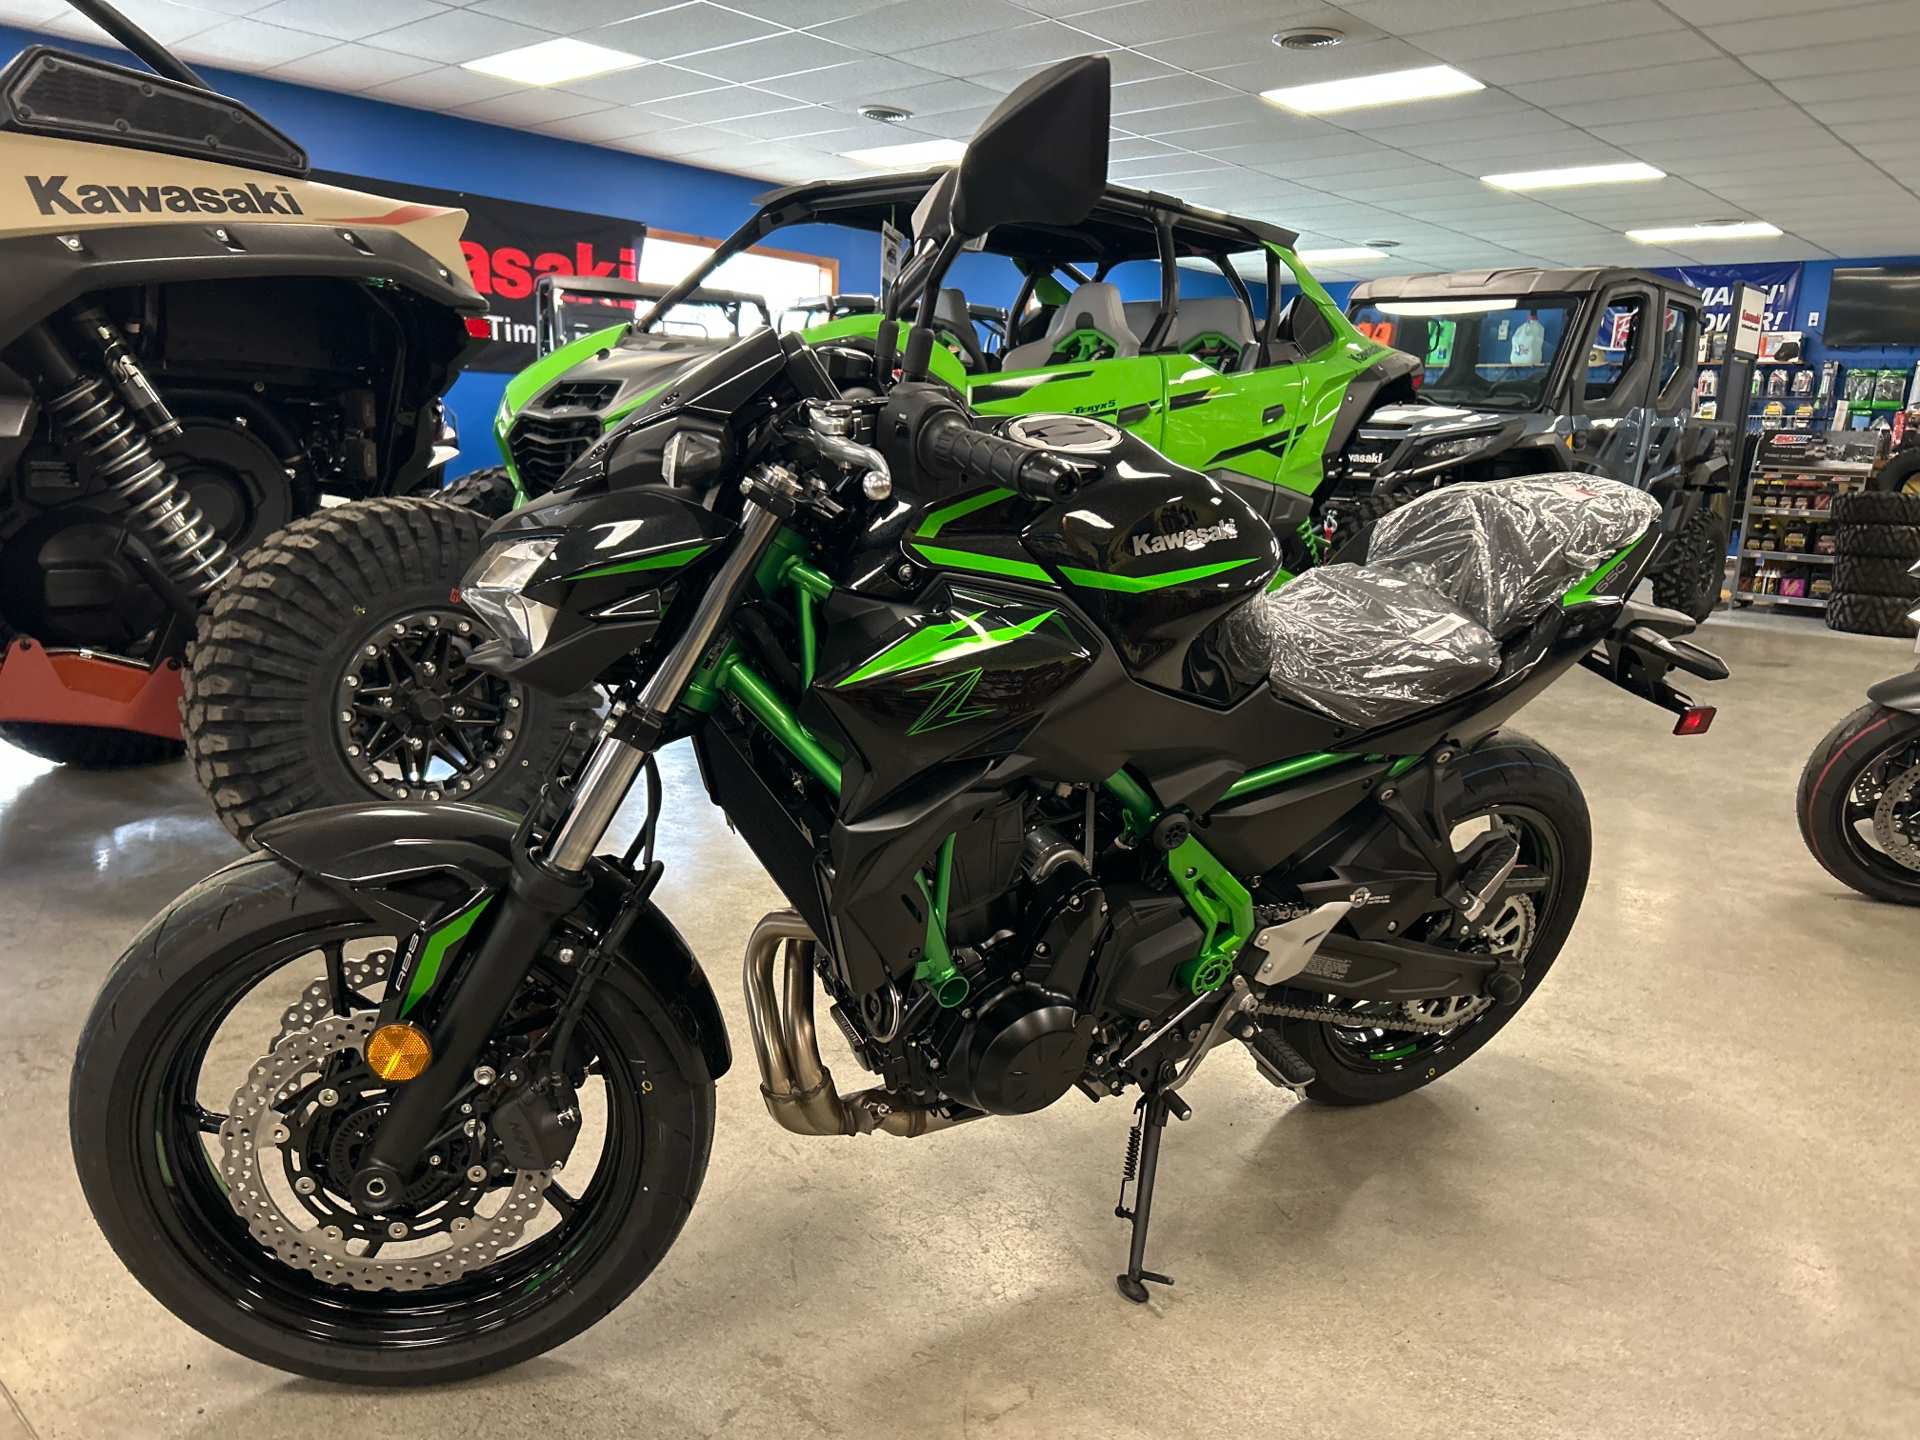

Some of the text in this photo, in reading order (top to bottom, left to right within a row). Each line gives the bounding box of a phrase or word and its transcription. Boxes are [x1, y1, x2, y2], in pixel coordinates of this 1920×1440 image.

[24, 175, 304, 215] Kawasaki
[459, 240, 636, 309] asaki
[484, 315, 537, 344] Tim
[1132, 518, 1238, 556] Kawasaki
[1595, 561, 1628, 593] 650
[395, 933, 420, 991] ABS
